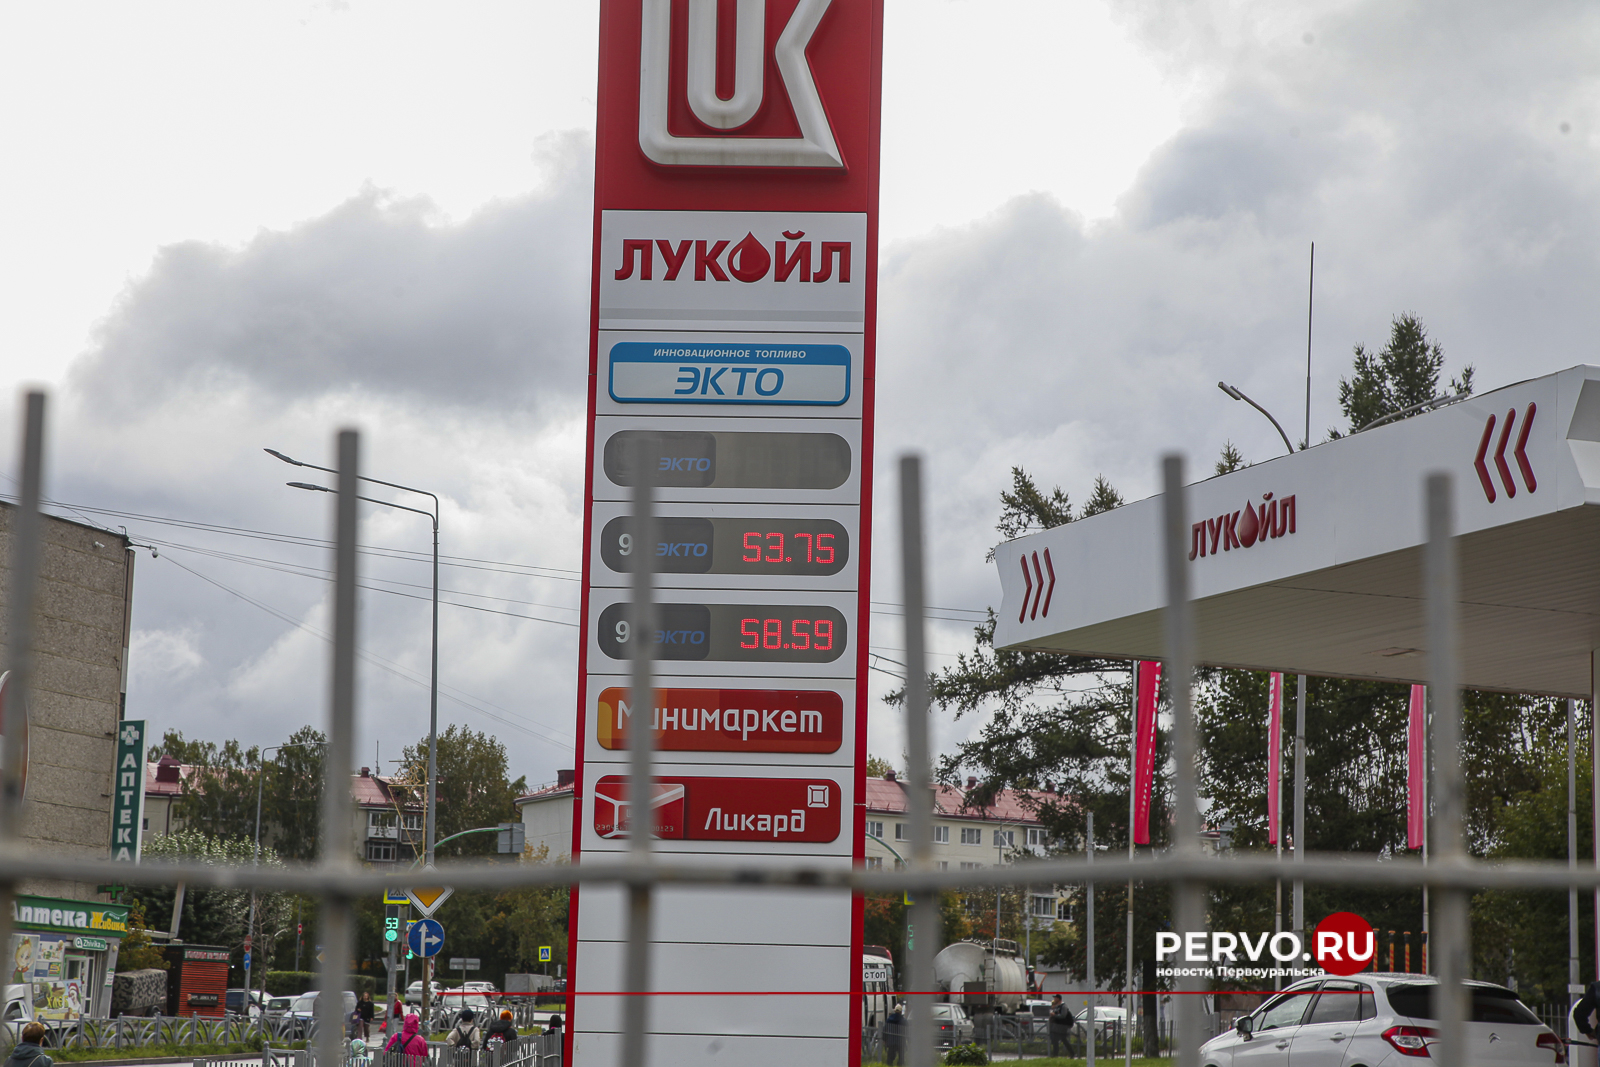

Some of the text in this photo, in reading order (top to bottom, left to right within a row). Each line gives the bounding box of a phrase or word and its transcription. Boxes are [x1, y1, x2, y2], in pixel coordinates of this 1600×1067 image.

[614, 229, 852, 284] ЛУКОЙЛ
[653, 348, 807, 359] ИННОВАЦИОННОЕ ТОПЛИВО
[674, 366, 785, 396] ЭКТО
[658, 457, 711, 472] ЭКТО
[1188, 491, 1296, 562] ЛУКОЙЛ
[655, 542, 708, 557] ЭКТО
[742, 531, 835, 564] 53.75
[653, 629, 705, 645] ЭКТО
[740, 618, 834, 650] 58.59
[115, 753, 137, 862] АПТЕКА
[704, 807, 806, 838] Ликард
[385, 917, 399, 930] 53
